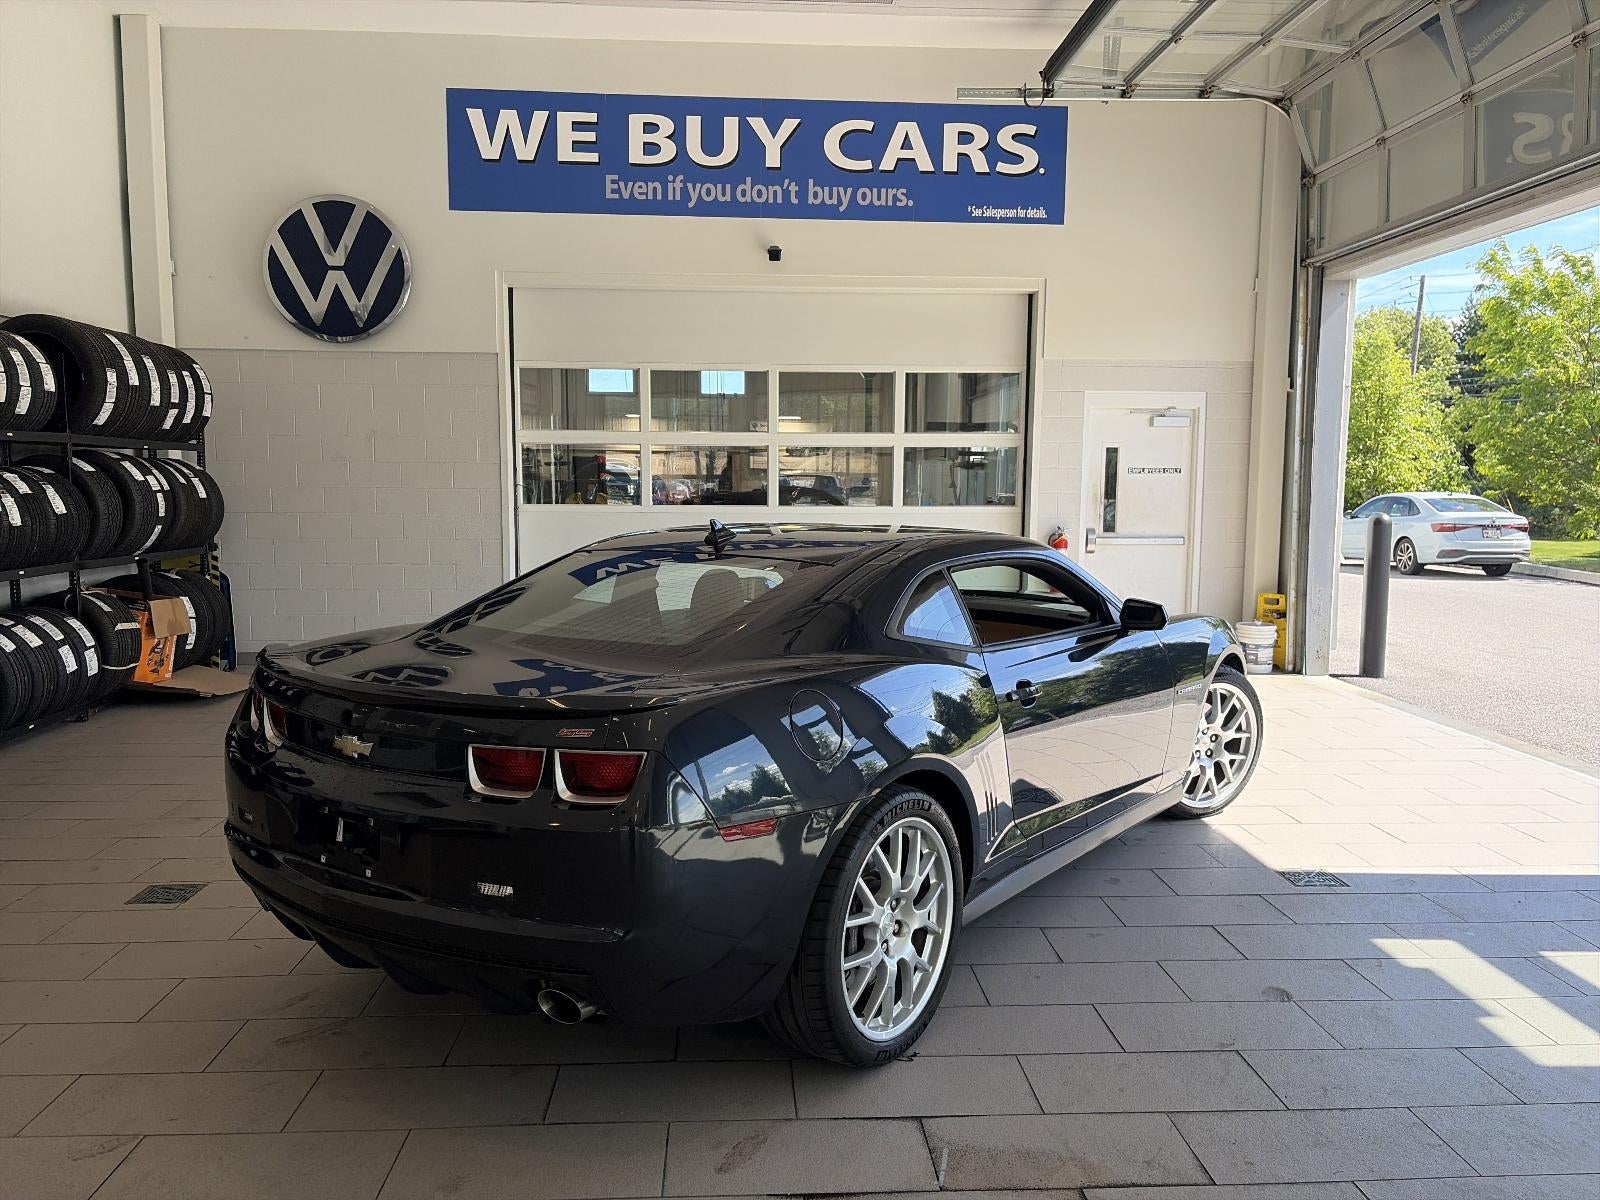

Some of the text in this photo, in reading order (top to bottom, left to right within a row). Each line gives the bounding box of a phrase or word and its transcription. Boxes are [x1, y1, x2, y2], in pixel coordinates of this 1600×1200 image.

[465, 107, 1046, 176] WE BUY CARS.
[605, 174, 914, 212] Even if you don't buy ours.
[983, 205, 1017, 220] Salesperson
[1017, 206, 1028, 218] for
[1027, 206, 1048, 219] details.
[1127, 467, 1182, 475] EMPLOYEES ONLY
[883, 799, 932, 825] MICHELIN
